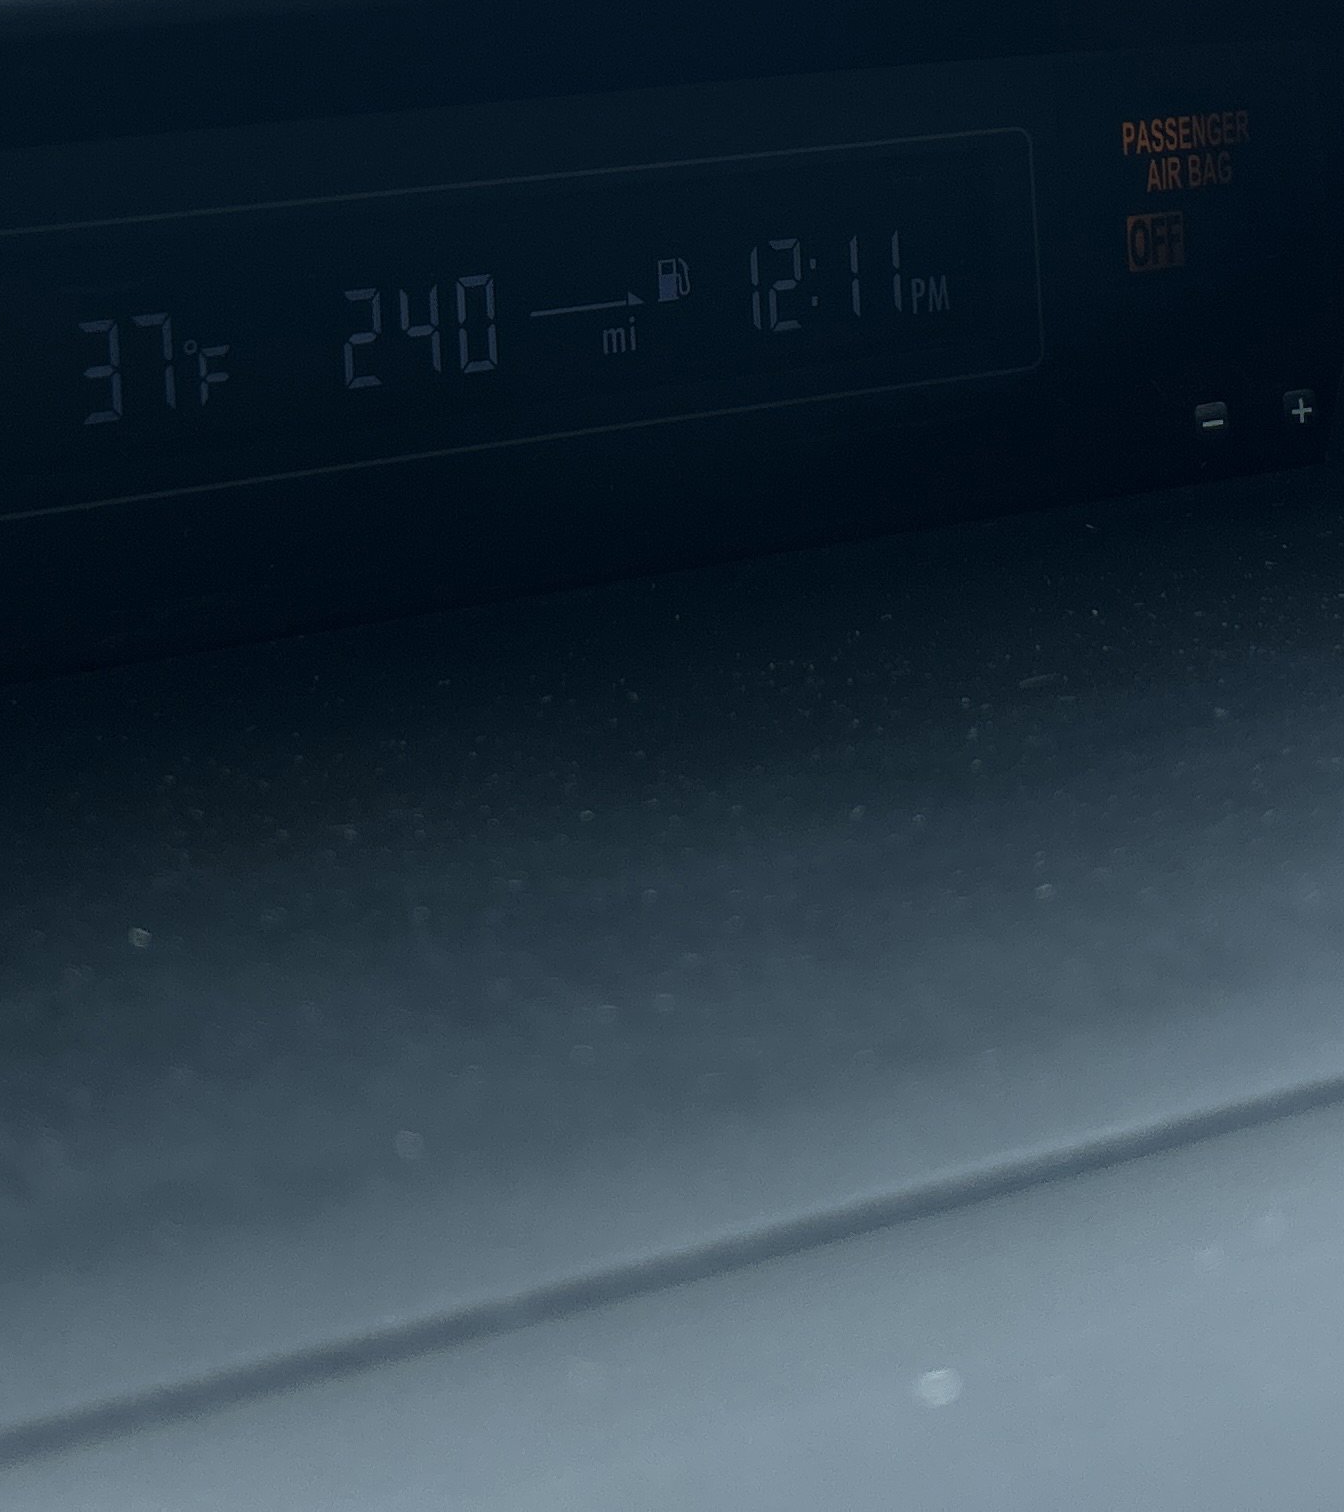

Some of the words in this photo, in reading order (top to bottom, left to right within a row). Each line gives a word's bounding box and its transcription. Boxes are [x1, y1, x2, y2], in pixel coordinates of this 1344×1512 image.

[1120, 108, 1249, 156] PASSENGER
[1146, 156, 1183, 193] AIR
[1187, 150, 1233, 187] BAG
[1129, 213, 1184, 271] OFF
[749, 228, 903, 333] 12:11
[909, 274, 952, 316] PM
[343, 271, 499, 390] 240
[601, 316, 638, 355] mi
